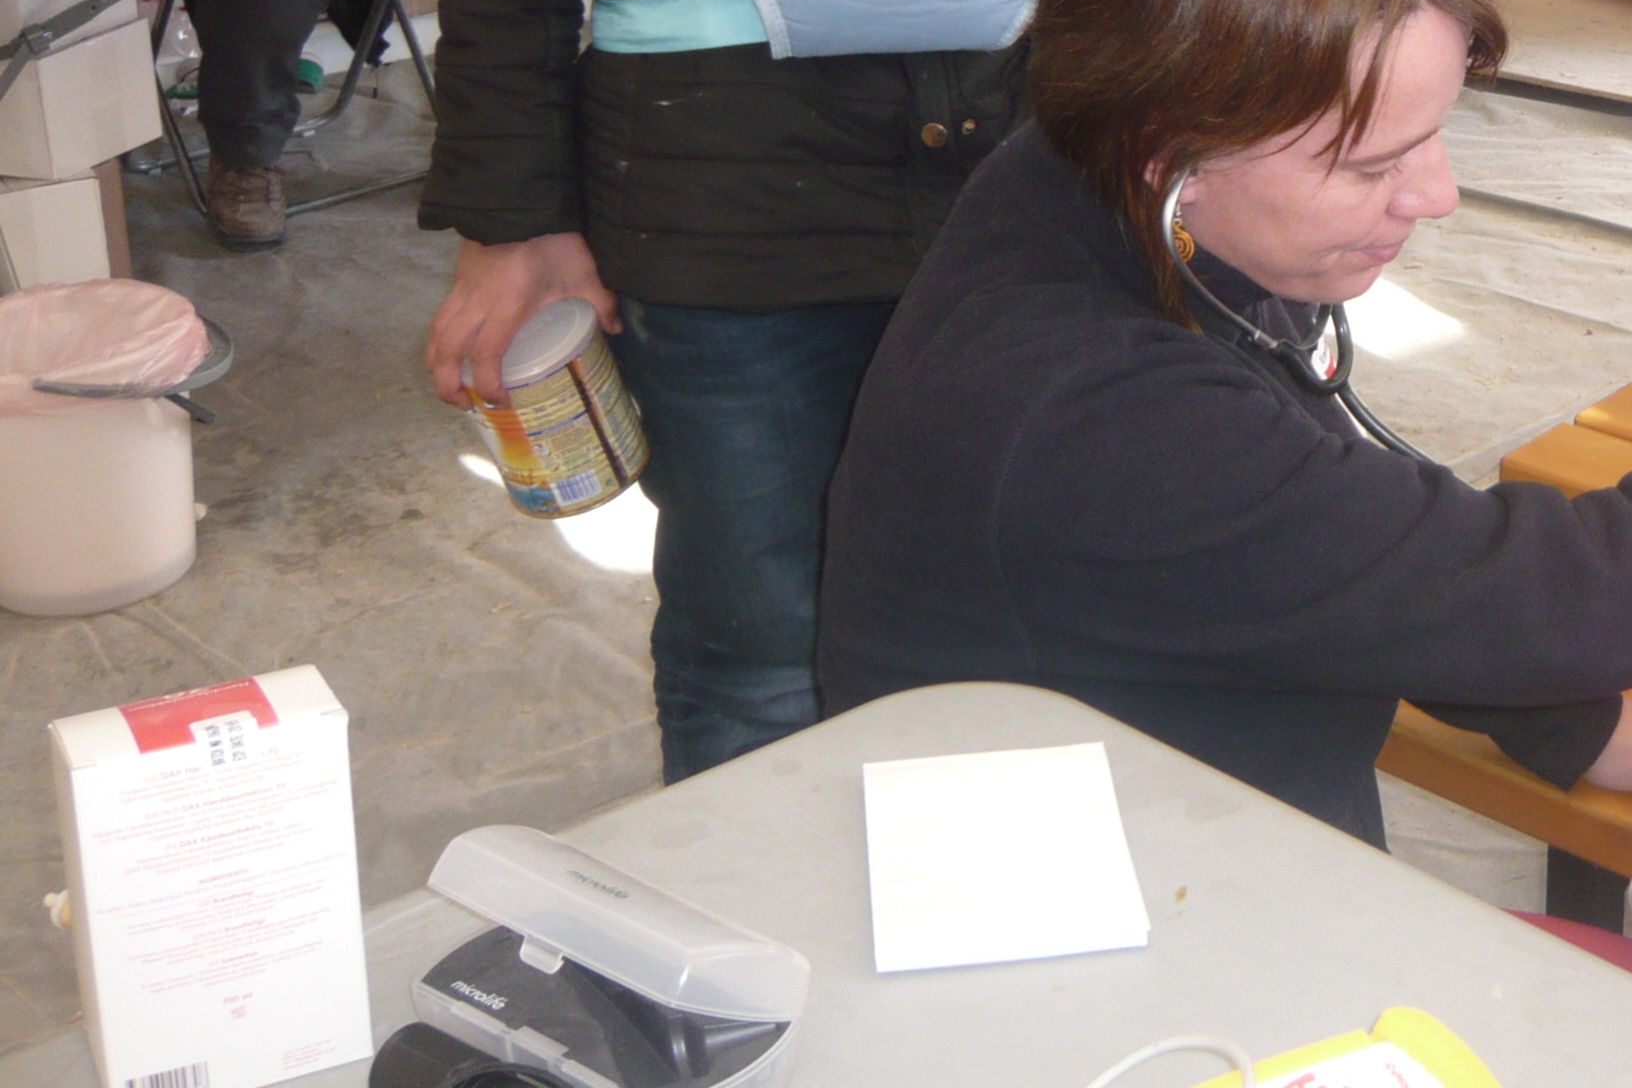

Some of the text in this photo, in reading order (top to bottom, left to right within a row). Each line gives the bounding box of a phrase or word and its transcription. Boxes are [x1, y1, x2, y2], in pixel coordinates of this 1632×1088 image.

[160, 769, 182, 780] DAX
[181, 802, 200, 812] DAX
[179, 838, 198, 848] DAX
[565, 869, 630, 899] microlife
[450, 980, 508, 1010] microlife
